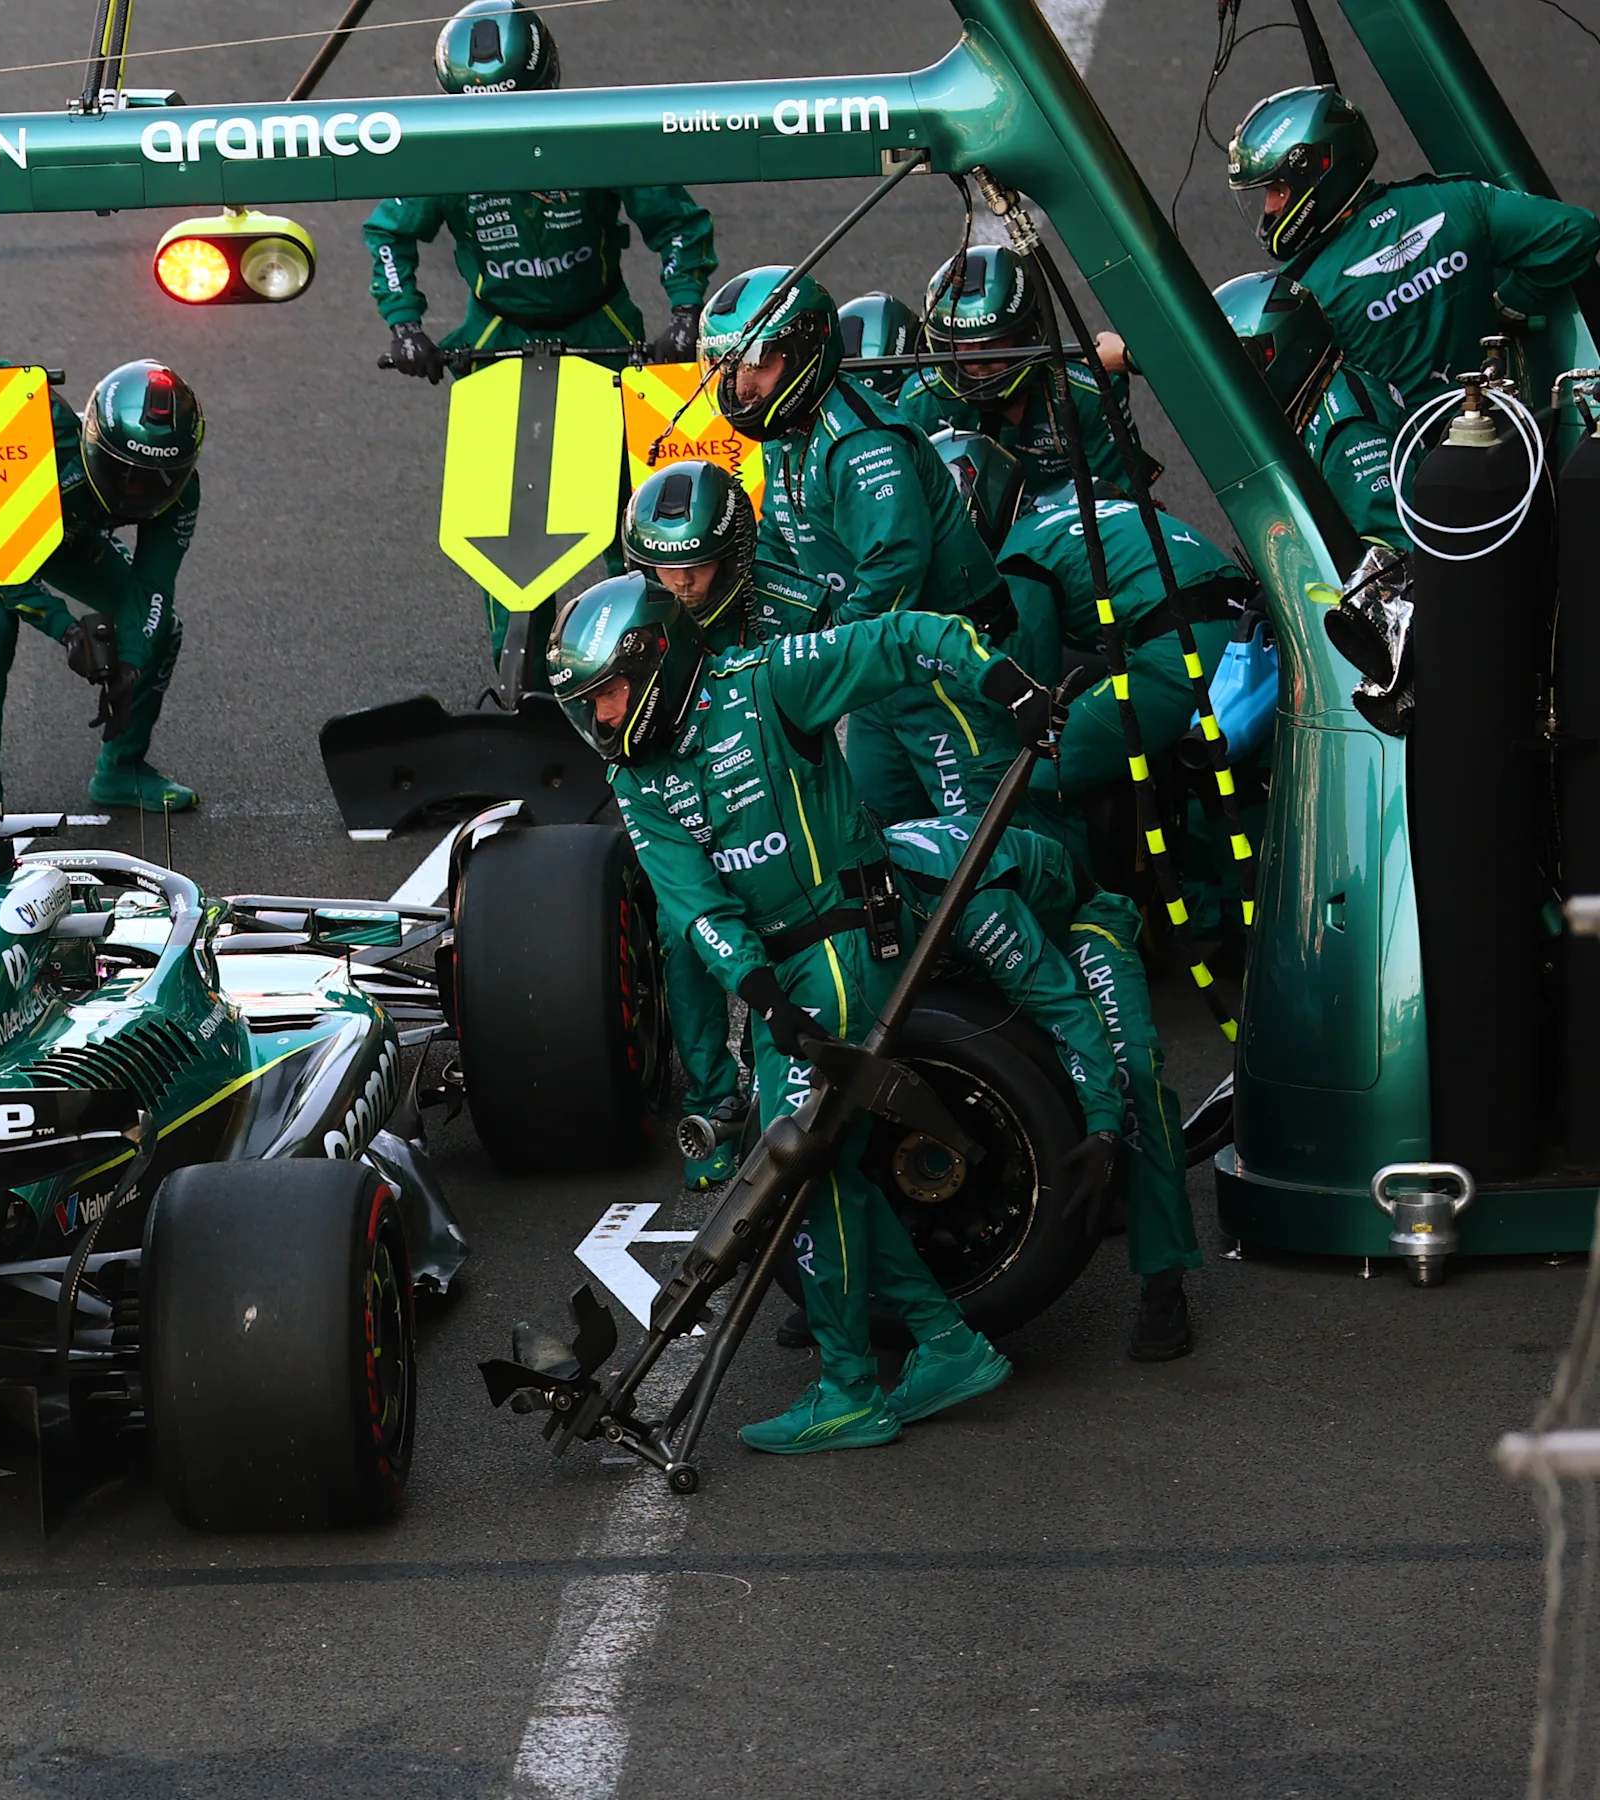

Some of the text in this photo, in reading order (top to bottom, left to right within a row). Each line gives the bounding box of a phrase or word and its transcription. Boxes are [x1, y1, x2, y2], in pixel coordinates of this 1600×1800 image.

[662, 95, 889, 135] Built on arm
[140, 111, 402, 162] aramco
[1250, 117, 1294, 163] Valvoline
[476, 211, 511, 226] BOSS
[1281, 199, 1316, 245] ASTON MARTIN
[1368, 207, 1398, 229] BOSS
[1378, 232, 1423, 265] ASTON MARTIN
[485, 246, 593, 279] aramco
[1006, 266, 1025, 315] Valvoline
[1366, 250, 1468, 322] aramco
[943, 312, 998, 328] aramco
[777, 366, 818, 417] ASTON MARTIN
[126, 439, 180, 458] aramco
[848, 444, 893, 467] servicenow
[1344, 437, 1387, 457] servicenow
[1360, 449, 1389, 463] NetApp
[865, 456, 894, 472] NetApp
[874, 483, 895, 501] citi
[1370, 474, 1391, 493] citi
[713, 488, 735, 537] Valvoline
[643, 538, 701, 552] aramco
[767, 581, 808, 601] coinbase
[583, 604, 613, 662] Valvoline
[632, 686, 661, 746] ASTON MARTIN
[677, 724, 698, 754] aramco
[711, 748, 752, 773] aramco
[726, 789, 766, 814] CoreWeave
[33, 858, 100, 867] VALHALLA
[711, 831, 788, 874] amco
[130, 866, 167, 882] aramco
[32, 883, 72, 918] CoreWeave
[984, 922, 1008, 950] NetApp
[1004, 949, 1025, 970] citi
[197, 1018, 216, 1041] ASTON
